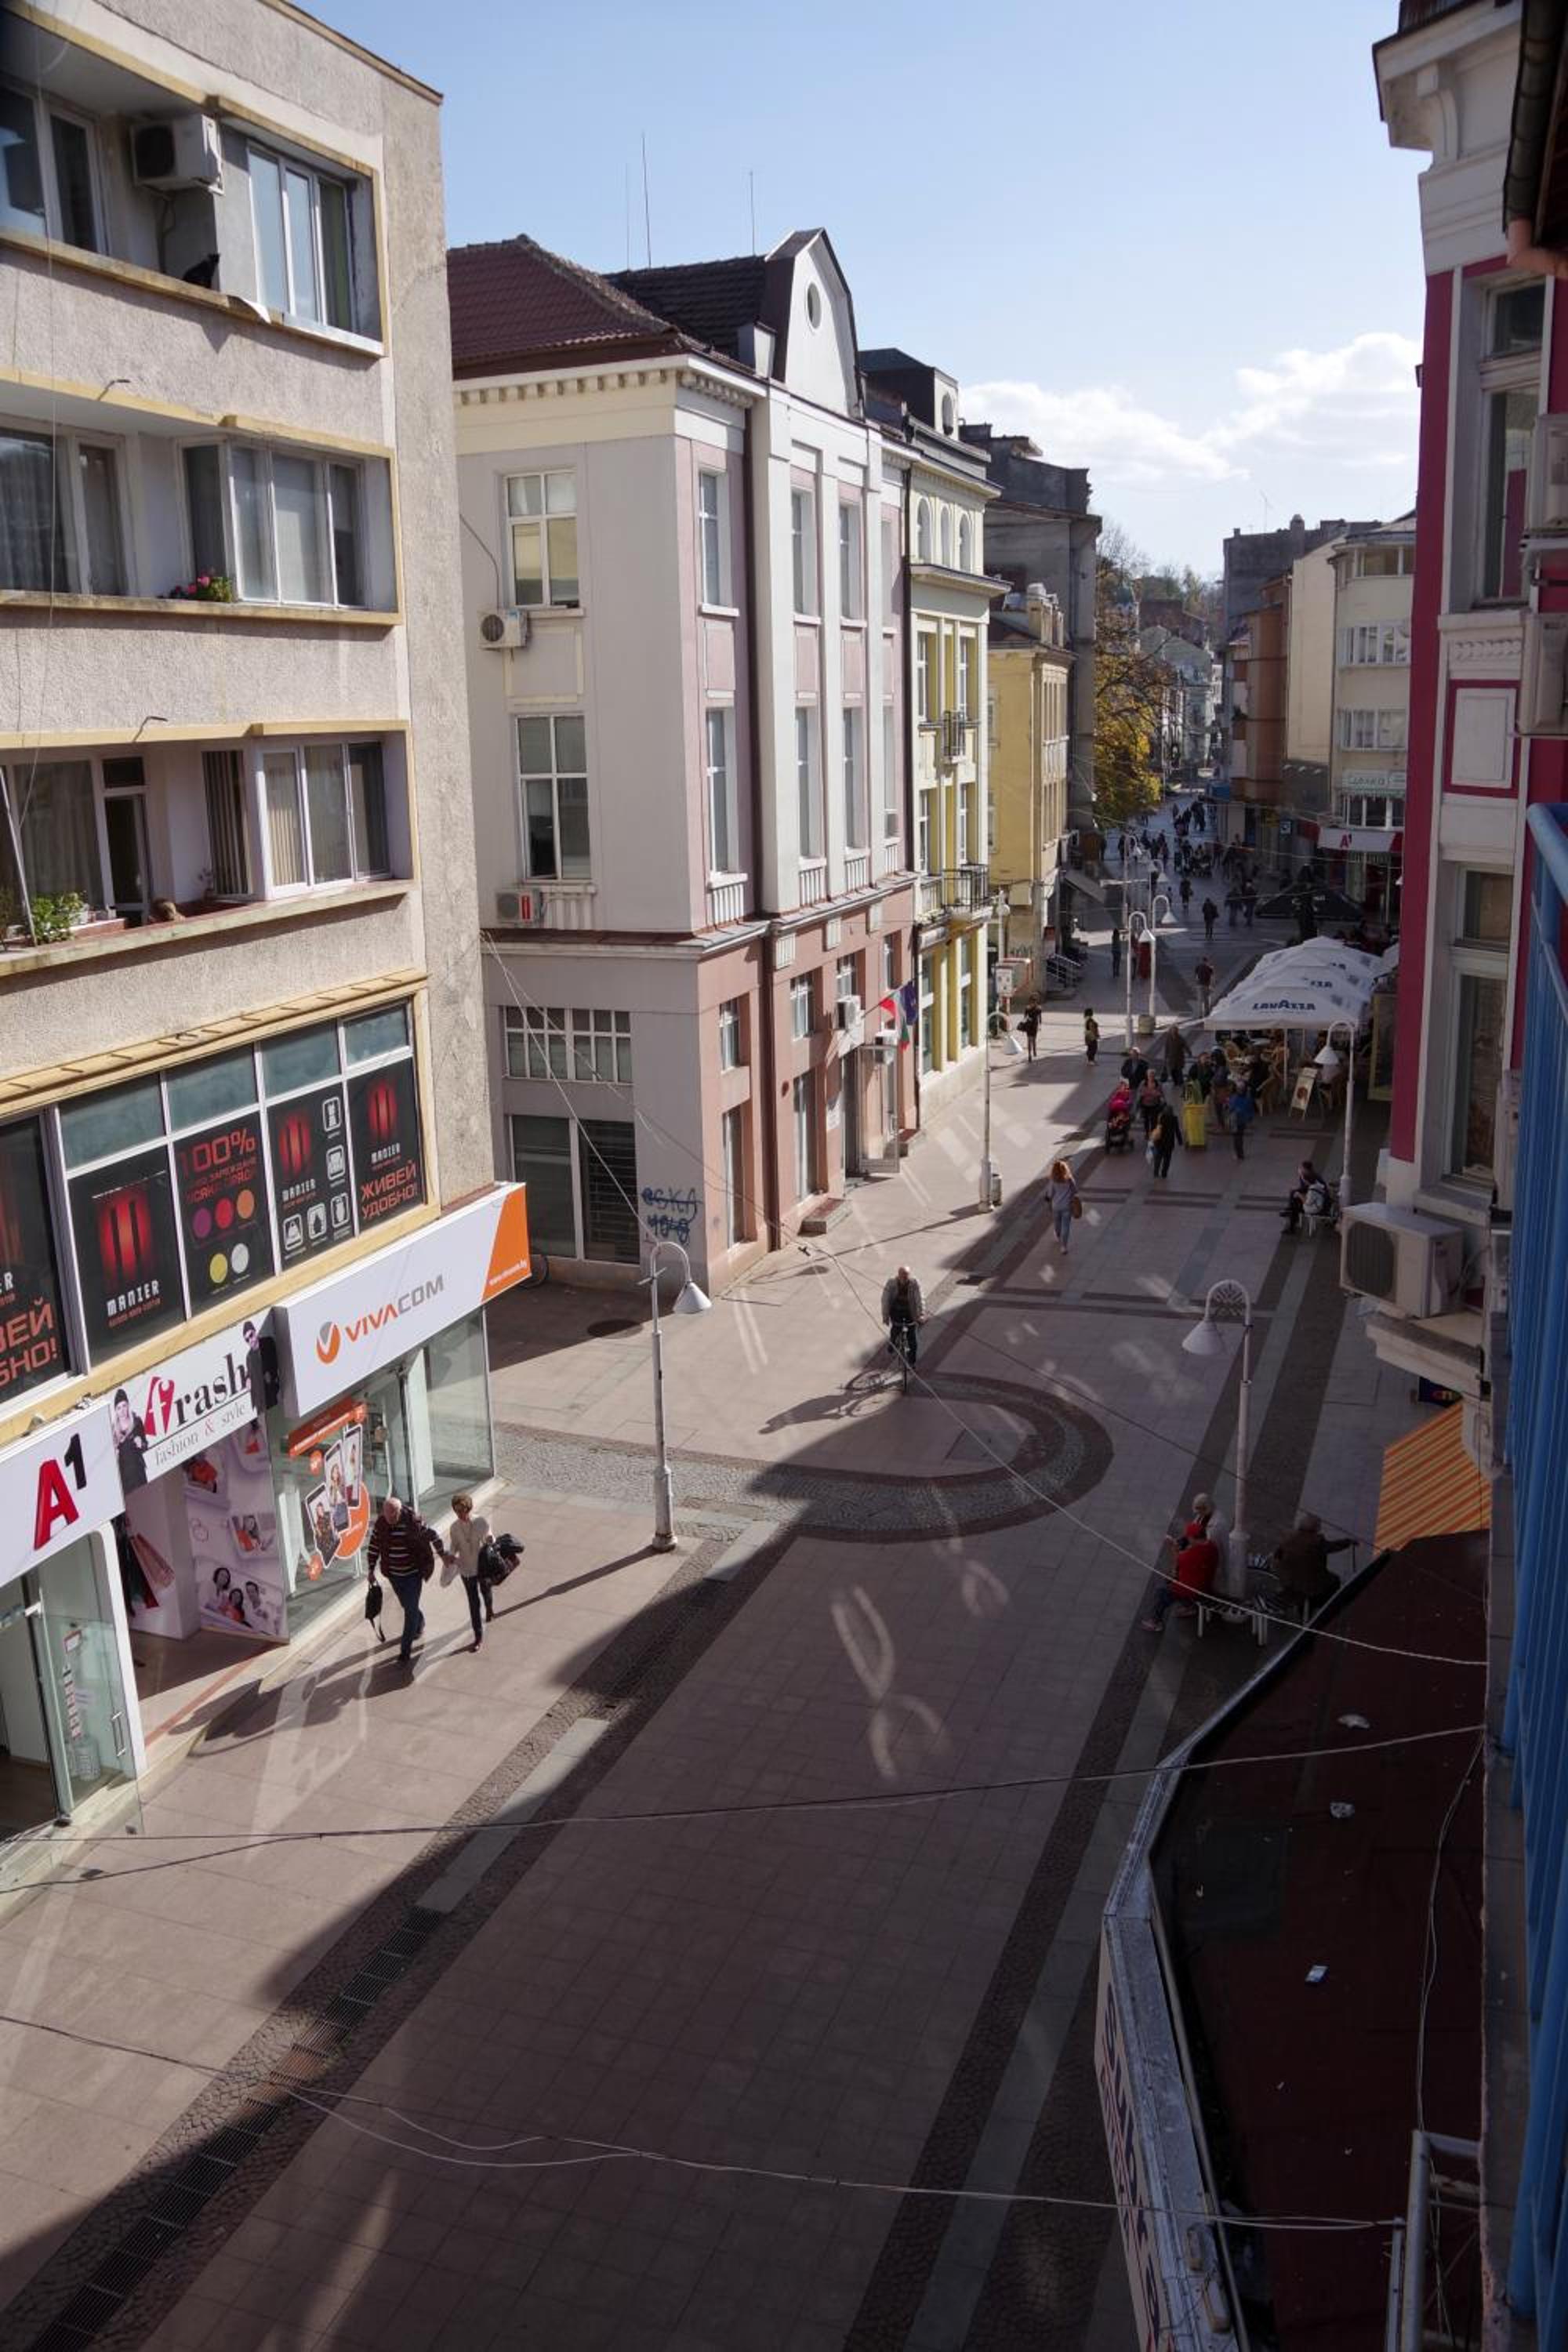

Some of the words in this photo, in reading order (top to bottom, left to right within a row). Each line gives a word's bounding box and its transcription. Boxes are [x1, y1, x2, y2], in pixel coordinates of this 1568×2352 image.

[1253, 1000, 1316, 1011] LAVAZZA
[180, 1129, 256, 1180] 100%
[361, 1160, 417, 1200] ЖИВЕЙ
[361, 1183, 418, 1220] УДОБНО!
[107, 1279, 160, 1317] MANIER
[345, 1275, 444, 1342] VIVACOM
[155, 1436, 199, 1466] fashion
[204, 1417, 215, 1436] &
[221, 1403, 245, 1427] style
[34, 1434, 87, 1551] A1
